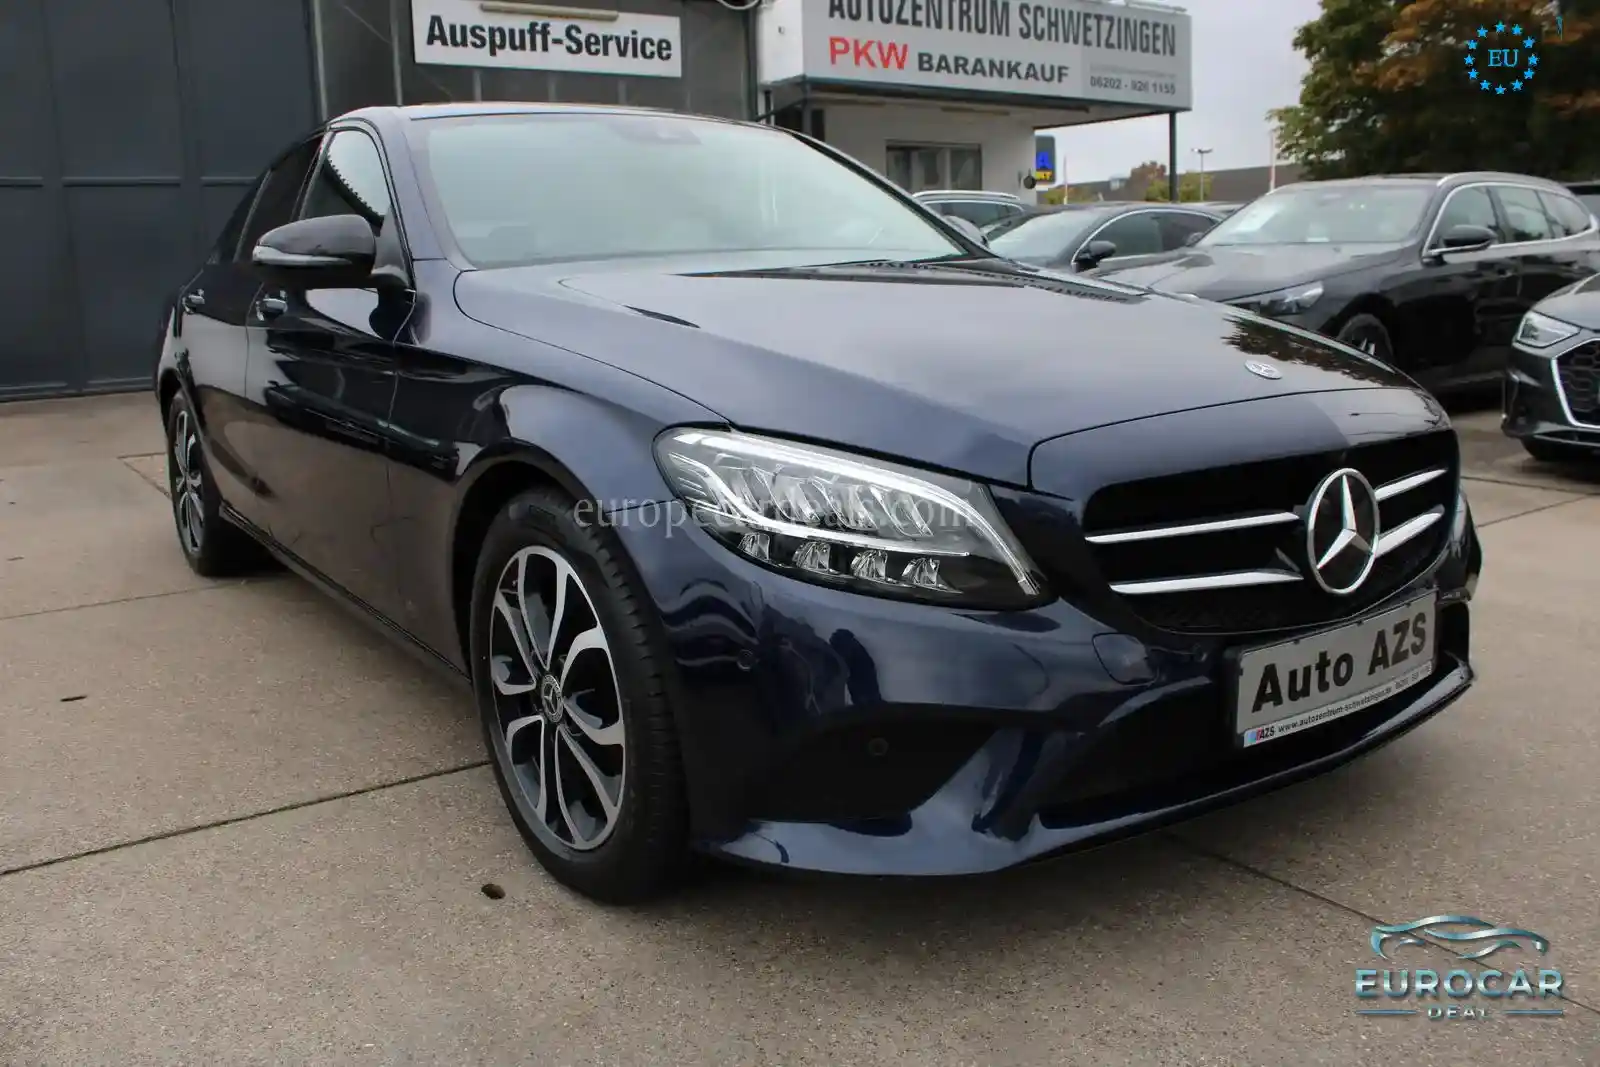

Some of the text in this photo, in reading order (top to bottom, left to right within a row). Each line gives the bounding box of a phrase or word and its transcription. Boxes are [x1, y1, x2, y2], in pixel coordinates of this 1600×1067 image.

[427, 15, 672, 61] Auspuff-Service
[1019, 3, 1176, 56] SCHWETZINGEN
[829, 36, 908, 71] PKW
[918, 52, 1070, 84] BARANKAUF
[1251, 650, 1354, 714] Auto
[1368, 612, 1427, 676] AZS
